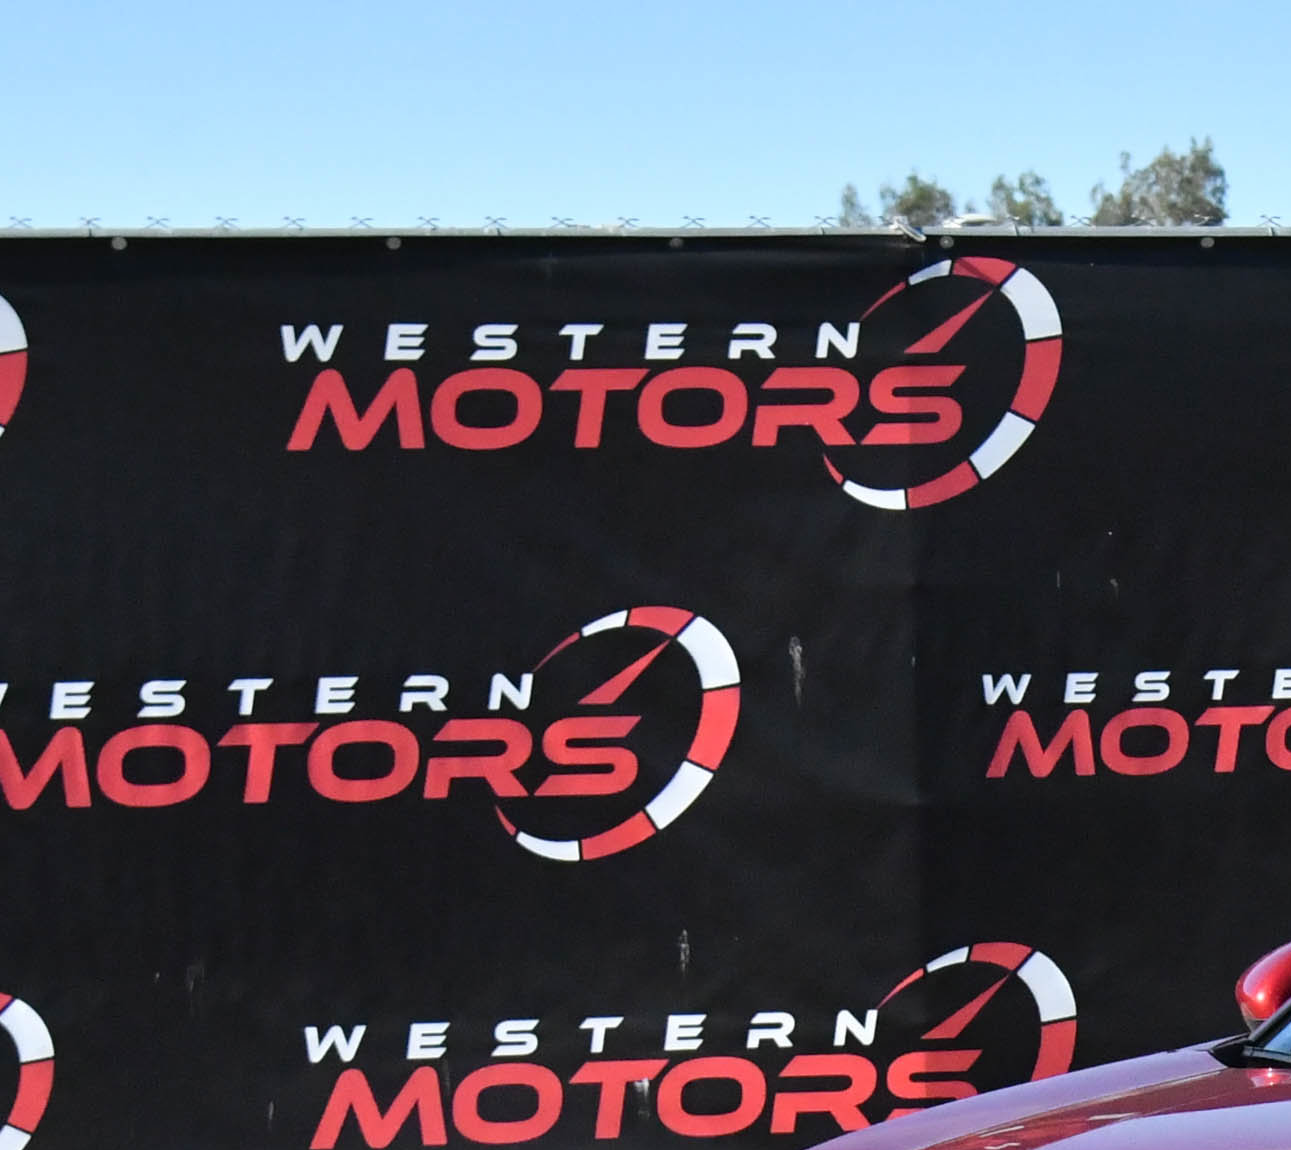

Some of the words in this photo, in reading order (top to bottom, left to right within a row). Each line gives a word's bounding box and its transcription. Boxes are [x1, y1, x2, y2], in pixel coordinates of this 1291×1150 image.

[282, 323, 860, 363] WESTERN
[287, 366, 966, 451] MOTORS
[0, 674, 534, 719] ESTERN
[0, 716, 641, 810] MOTORS
[304, 1010, 879, 1064] WESTERN
[309, 1050, 982, 1150] MOTORS
